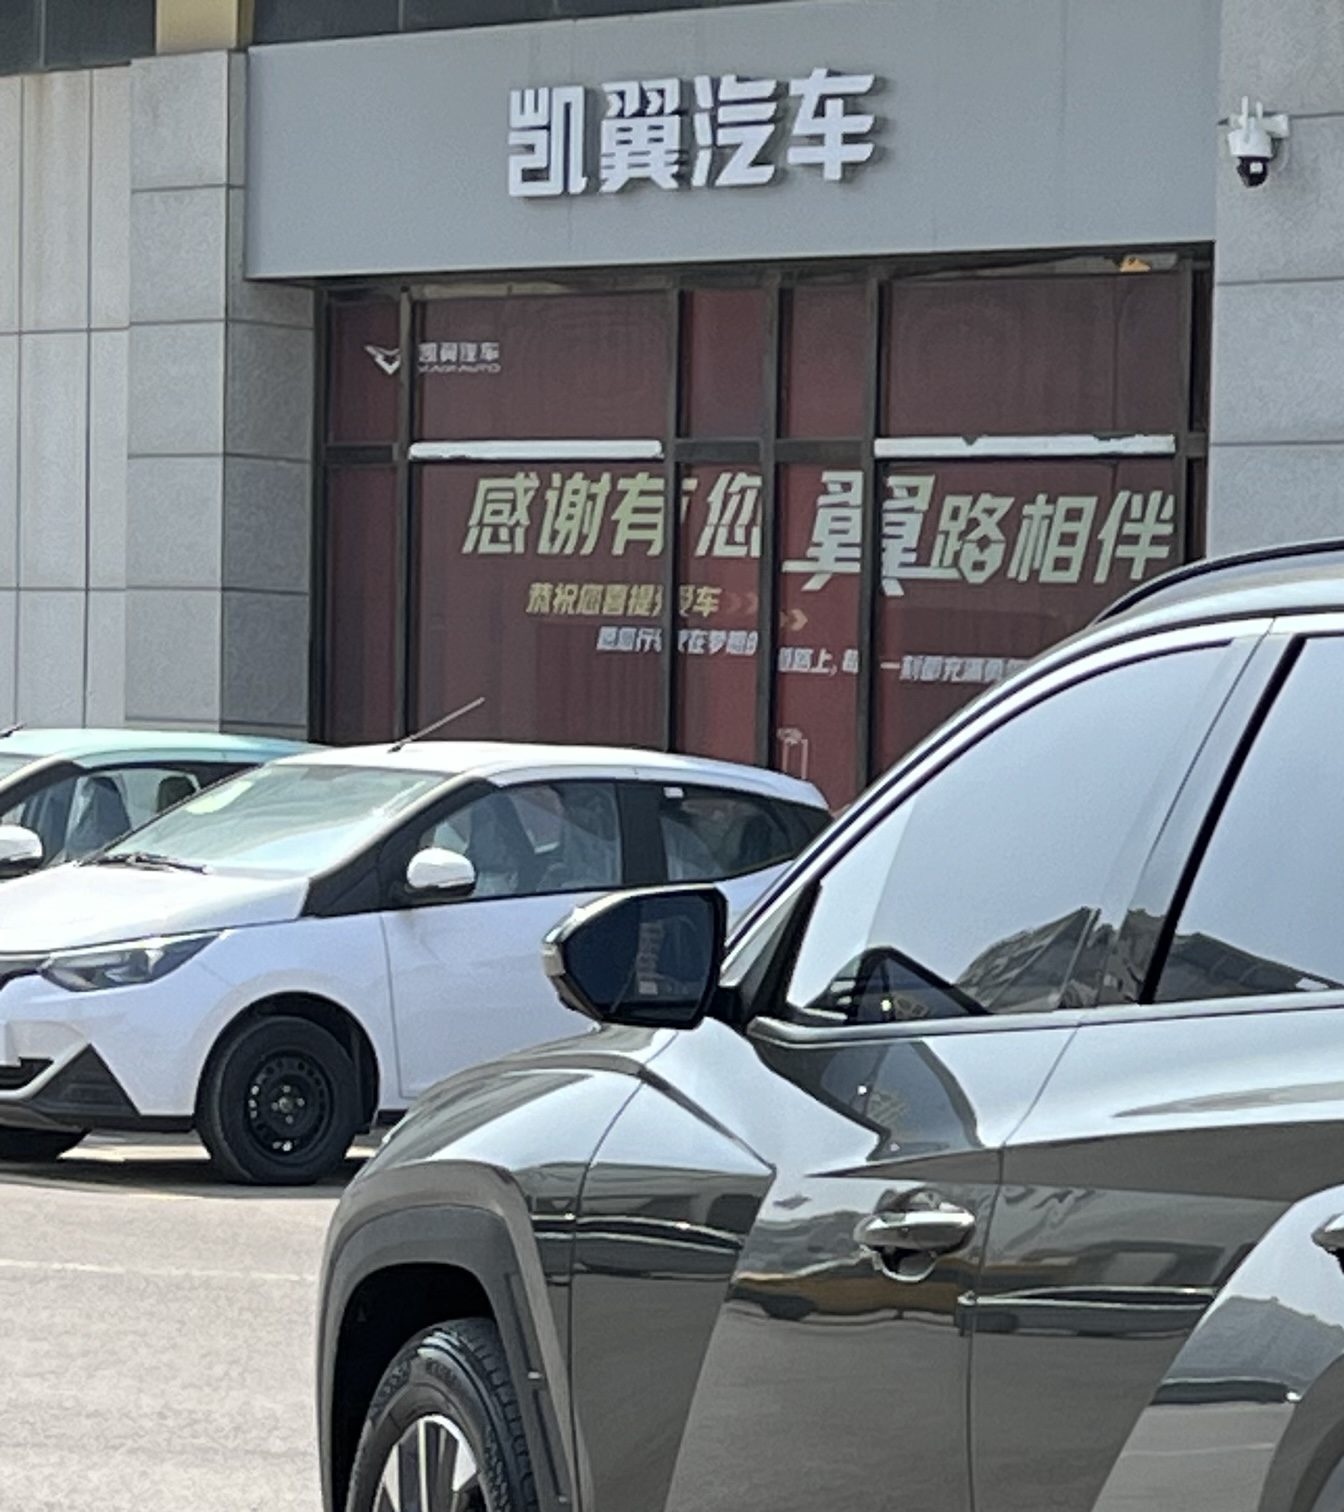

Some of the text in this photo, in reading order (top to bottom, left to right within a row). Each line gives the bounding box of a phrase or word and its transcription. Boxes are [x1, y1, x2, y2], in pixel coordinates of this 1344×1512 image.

[508, 67, 875, 197] 凯翼汽车
[461, 472, 762, 557] 感谢有您
